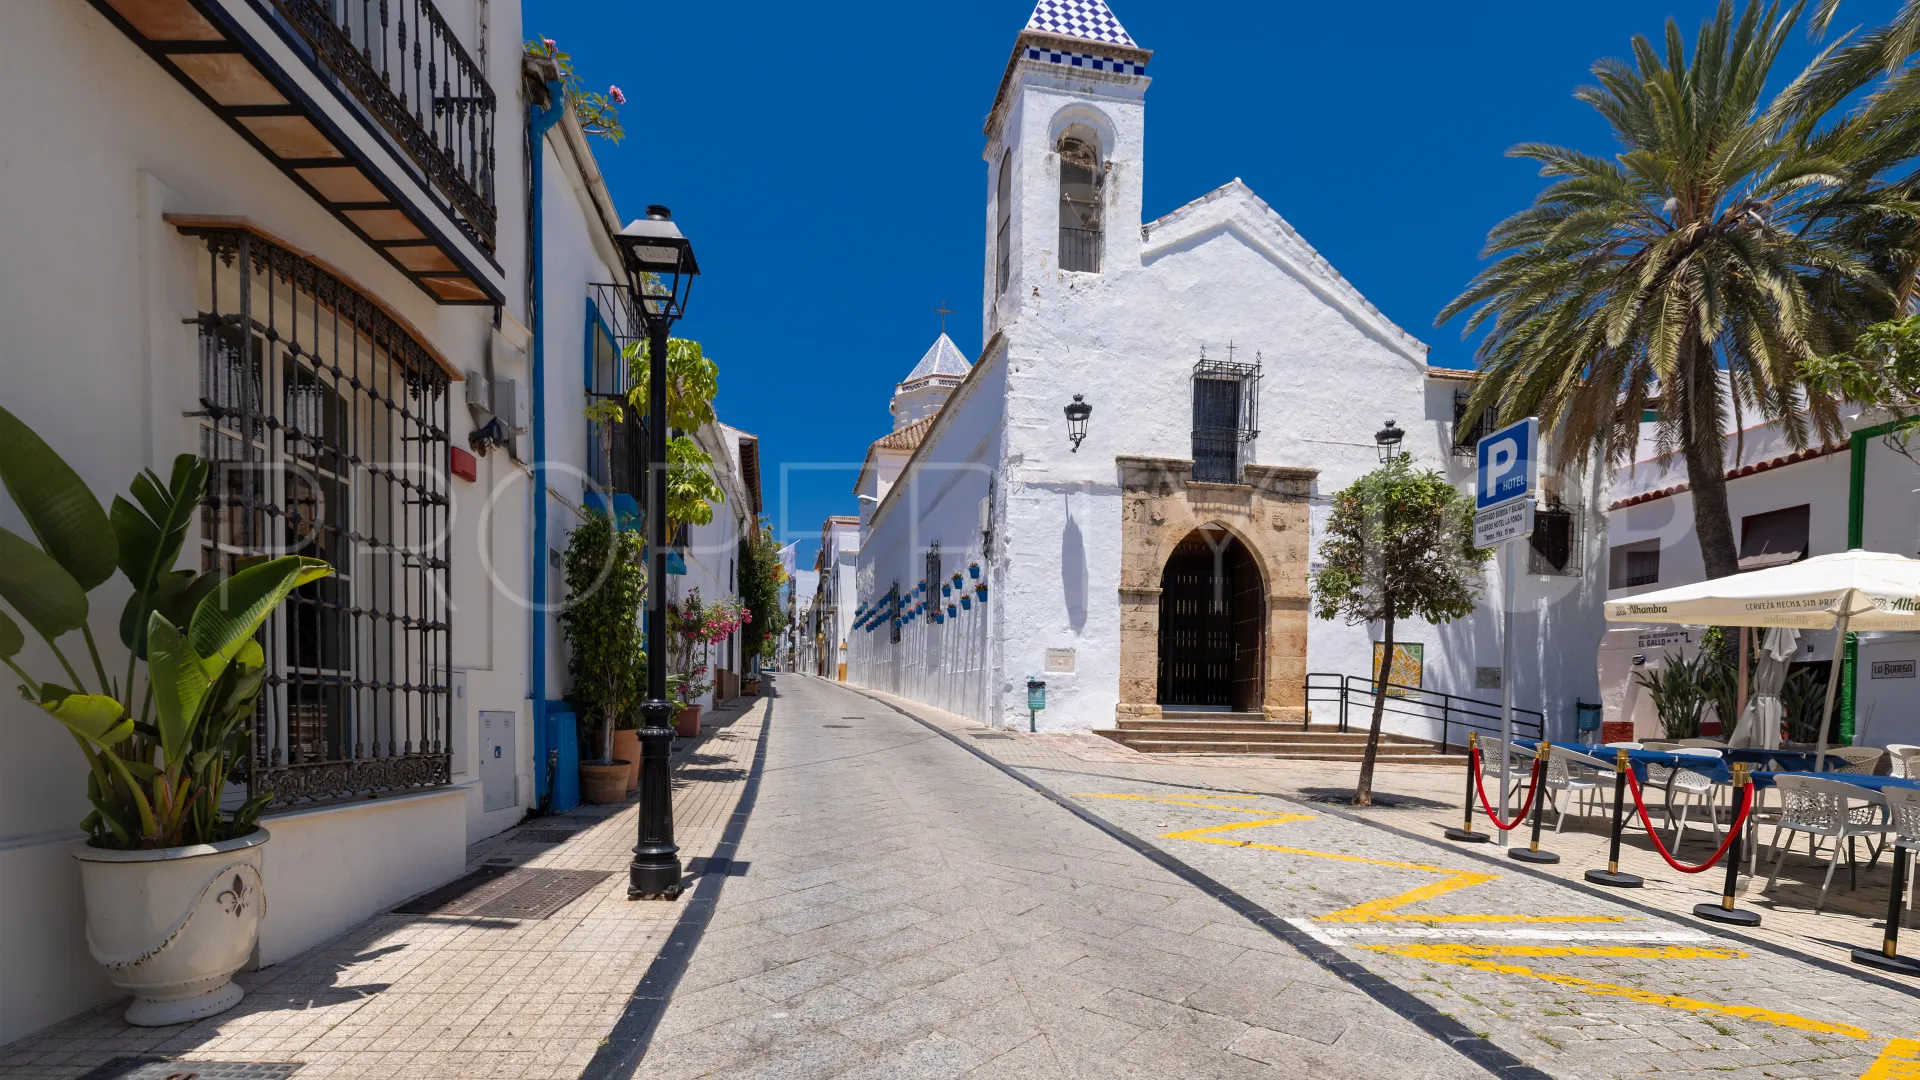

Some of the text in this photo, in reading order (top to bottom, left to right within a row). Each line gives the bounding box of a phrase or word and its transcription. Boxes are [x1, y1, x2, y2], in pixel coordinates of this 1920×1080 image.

[1487, 438, 1518, 498] P
[1503, 475, 1524, 491] HOTEL
[1476, 511, 1495, 524] RESERVADO
[1478, 513, 1523, 533] VIAJEROS HOTEL LA FONDA
[1626, 604, 1668, 615] Alhambra
[1745, 602, 1775, 611] CERVEZA
[1776, 600, 1801, 609] HECHA
[1802, 599, 1817, 607] SIN
[1638, 638, 1666, 648] EL GALLO
[1874, 665, 1883, 674] LA
[1884, 663, 1912, 675] BODEGA
